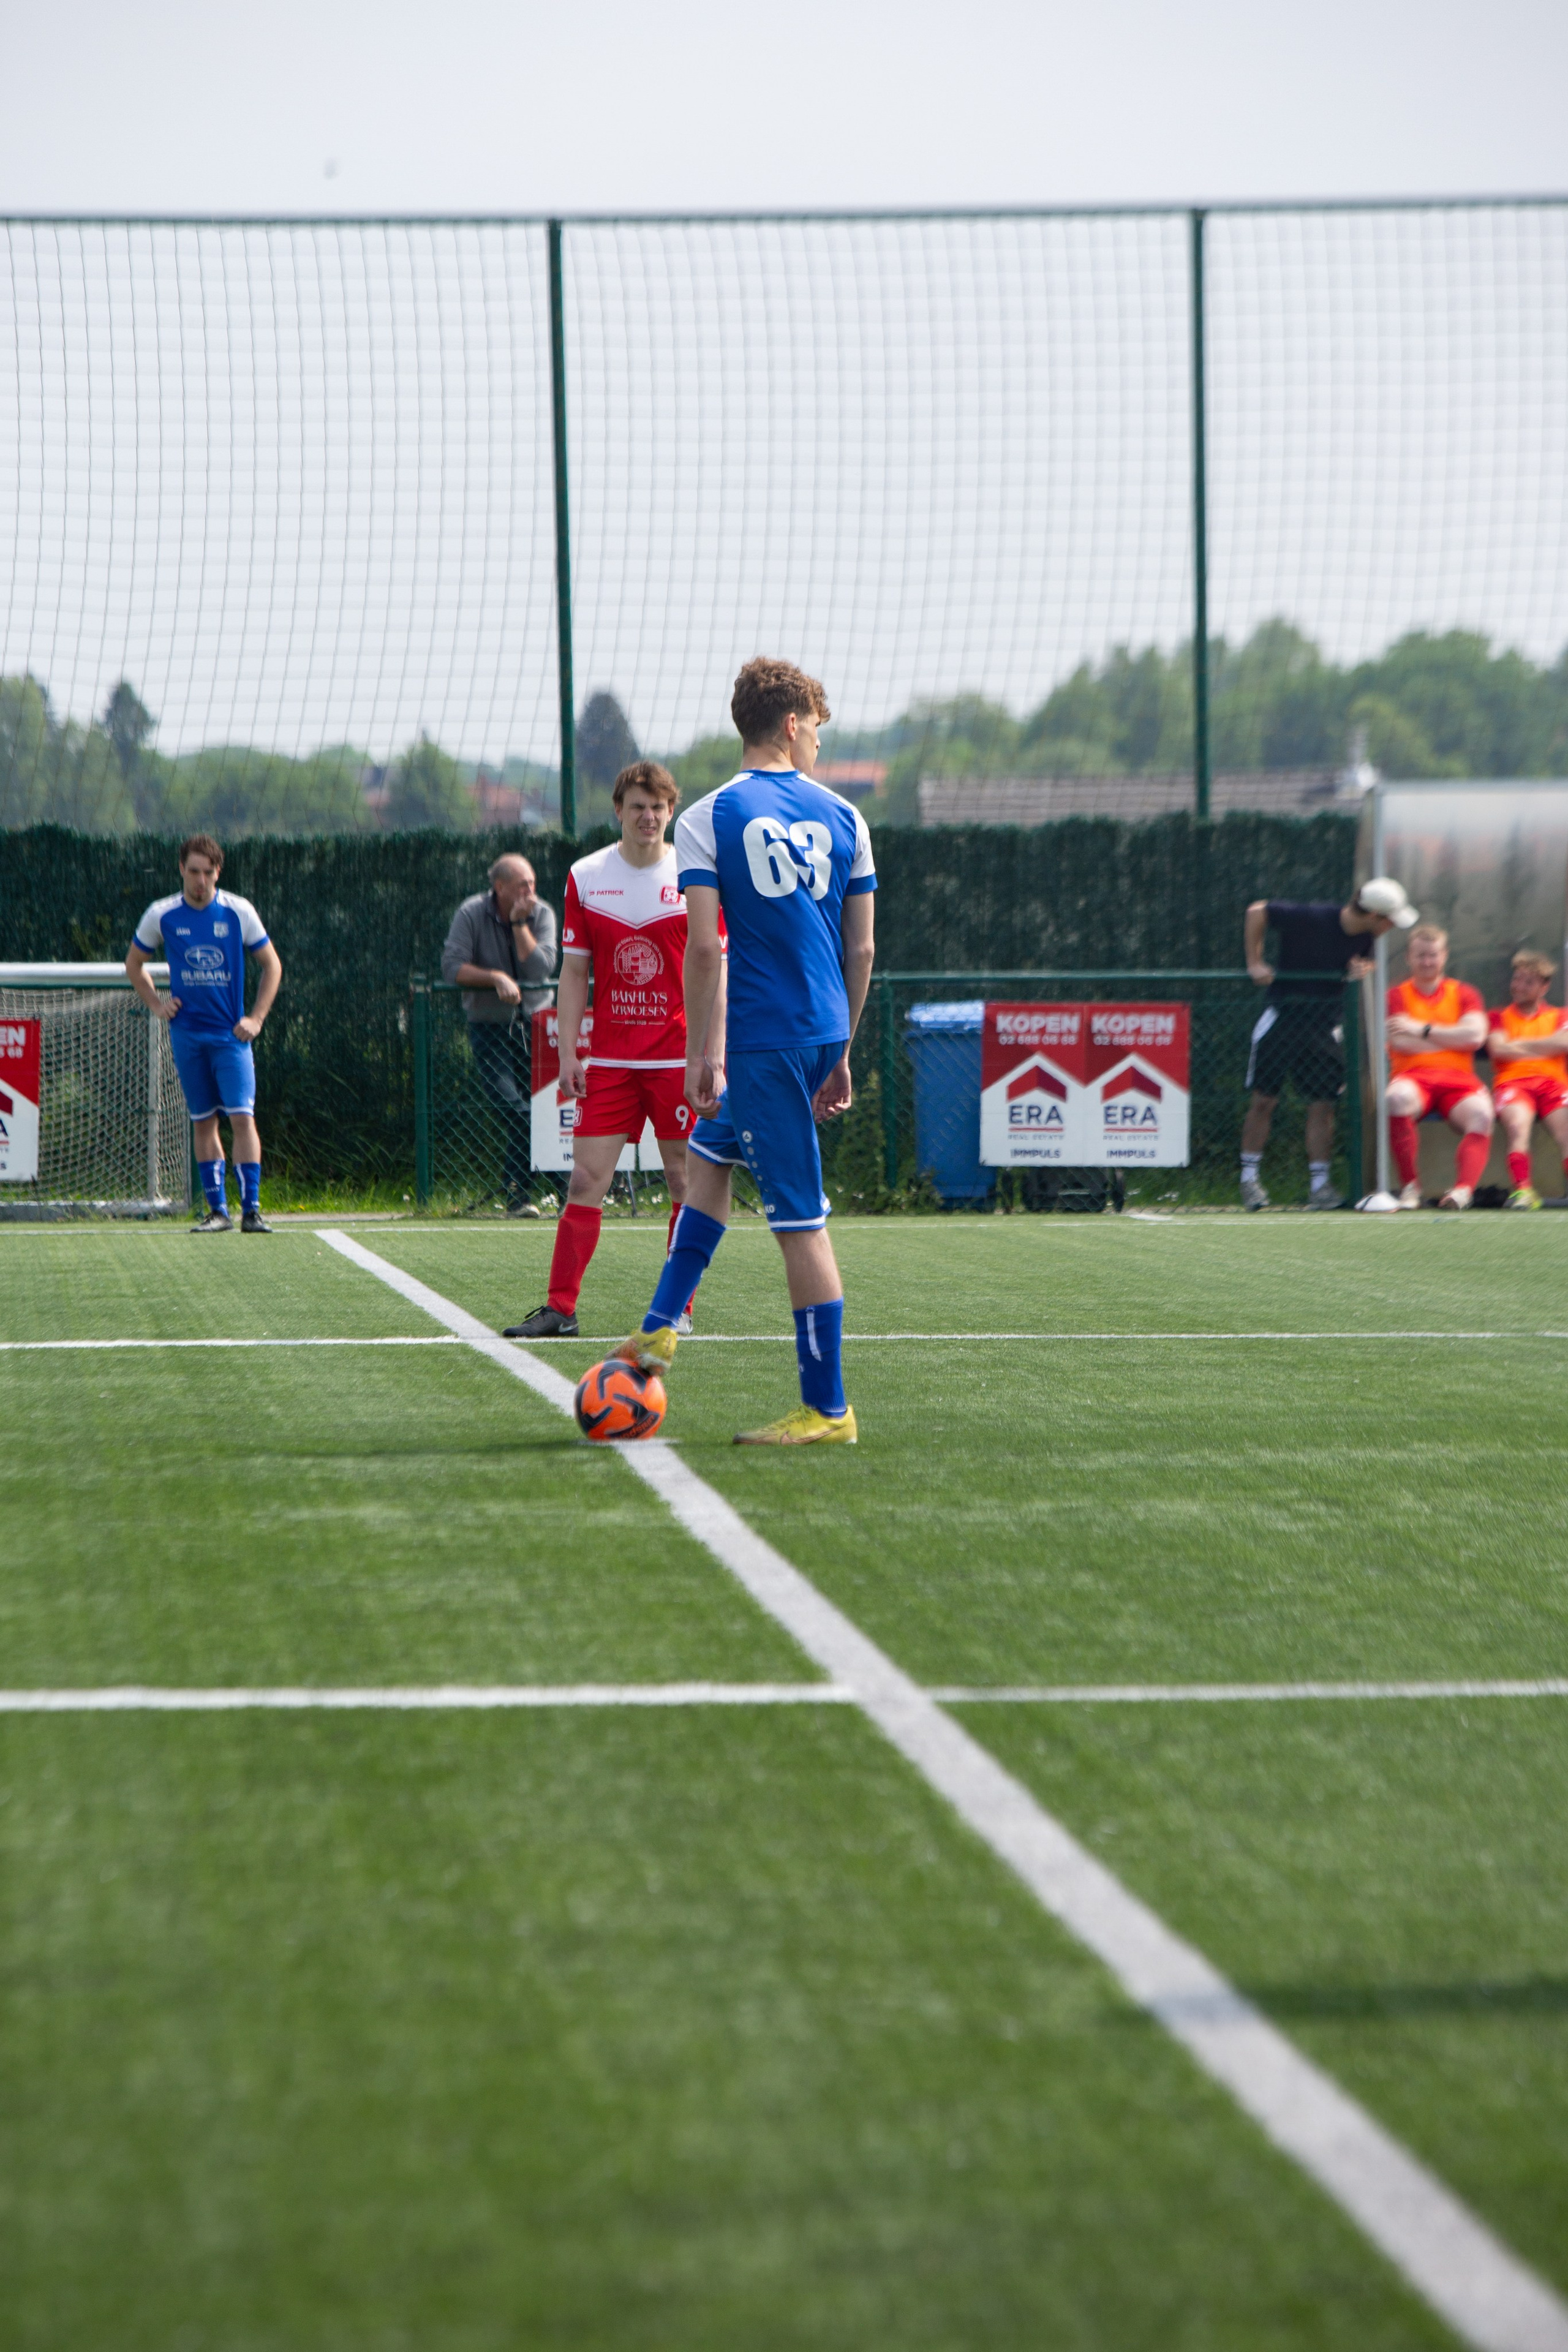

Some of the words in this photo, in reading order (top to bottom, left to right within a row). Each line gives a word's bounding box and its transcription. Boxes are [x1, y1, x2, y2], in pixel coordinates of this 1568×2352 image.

[743, 816, 832, 900] 63
[181, 969, 232, 982] SUBARU
[611, 989, 668, 1005] BAKHUYS
[611, 1005, 668, 1017] VERMOESEN
[996, 1013, 1080, 1033] KOPEN
[1091, 1013, 1175, 1034] KOPEN
[676, 1105, 689, 1130] 9
[1009, 1105, 1063, 1125] ERA
[1104, 1105, 1158, 1125] ERA
[1011, 1149, 1060, 1158] IMMPULS
[1106, 1149, 1156, 1158] IMMPULS
